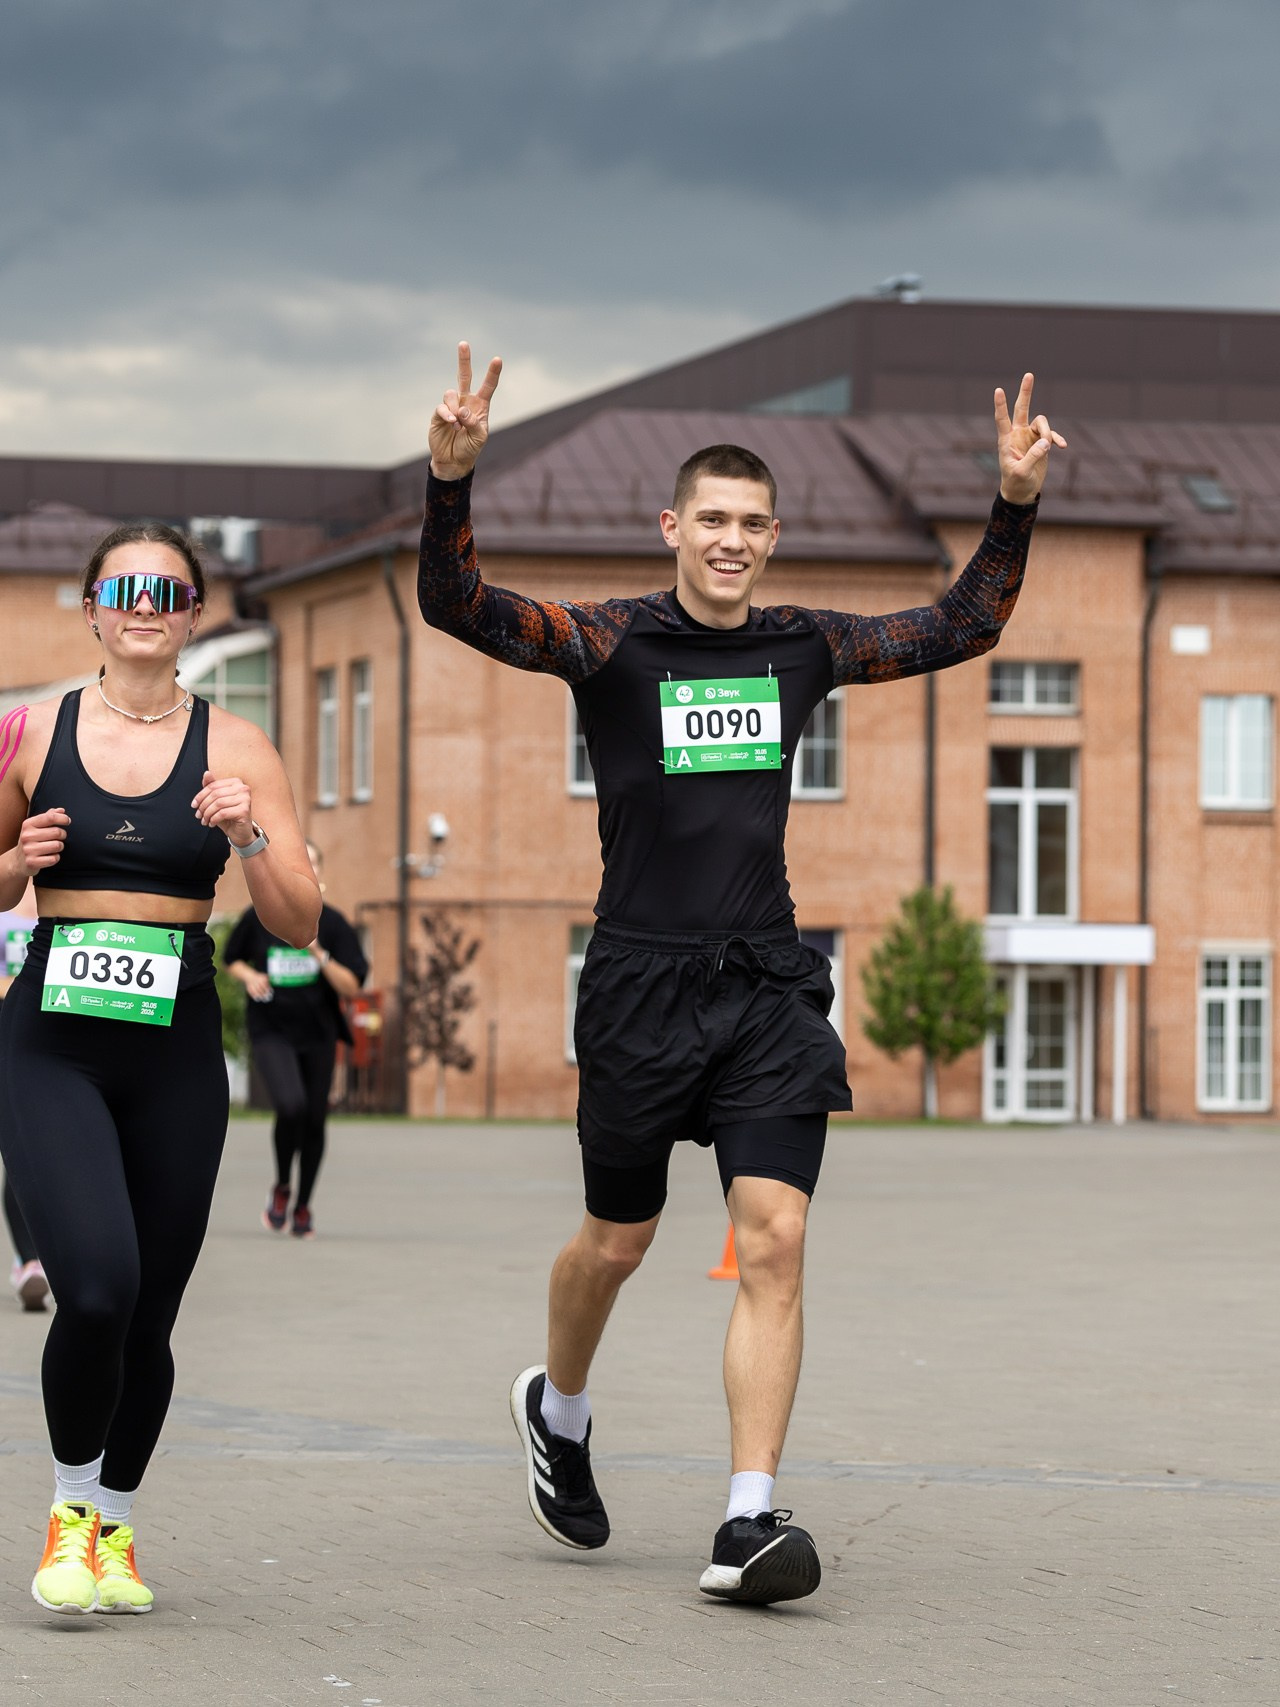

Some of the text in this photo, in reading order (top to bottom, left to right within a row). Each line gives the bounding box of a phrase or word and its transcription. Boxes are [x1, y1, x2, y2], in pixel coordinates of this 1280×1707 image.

[717, 688, 740, 698] Звук
[686, 708, 761, 740] 0090
[105, 834, 144, 843] DEMIX
[110, 931, 136, 944] Звук
[70, 951, 154, 989] 0336
[142, 1001, 157, 1009] 30.05
[141, 1008, 154, 1016] 2026
